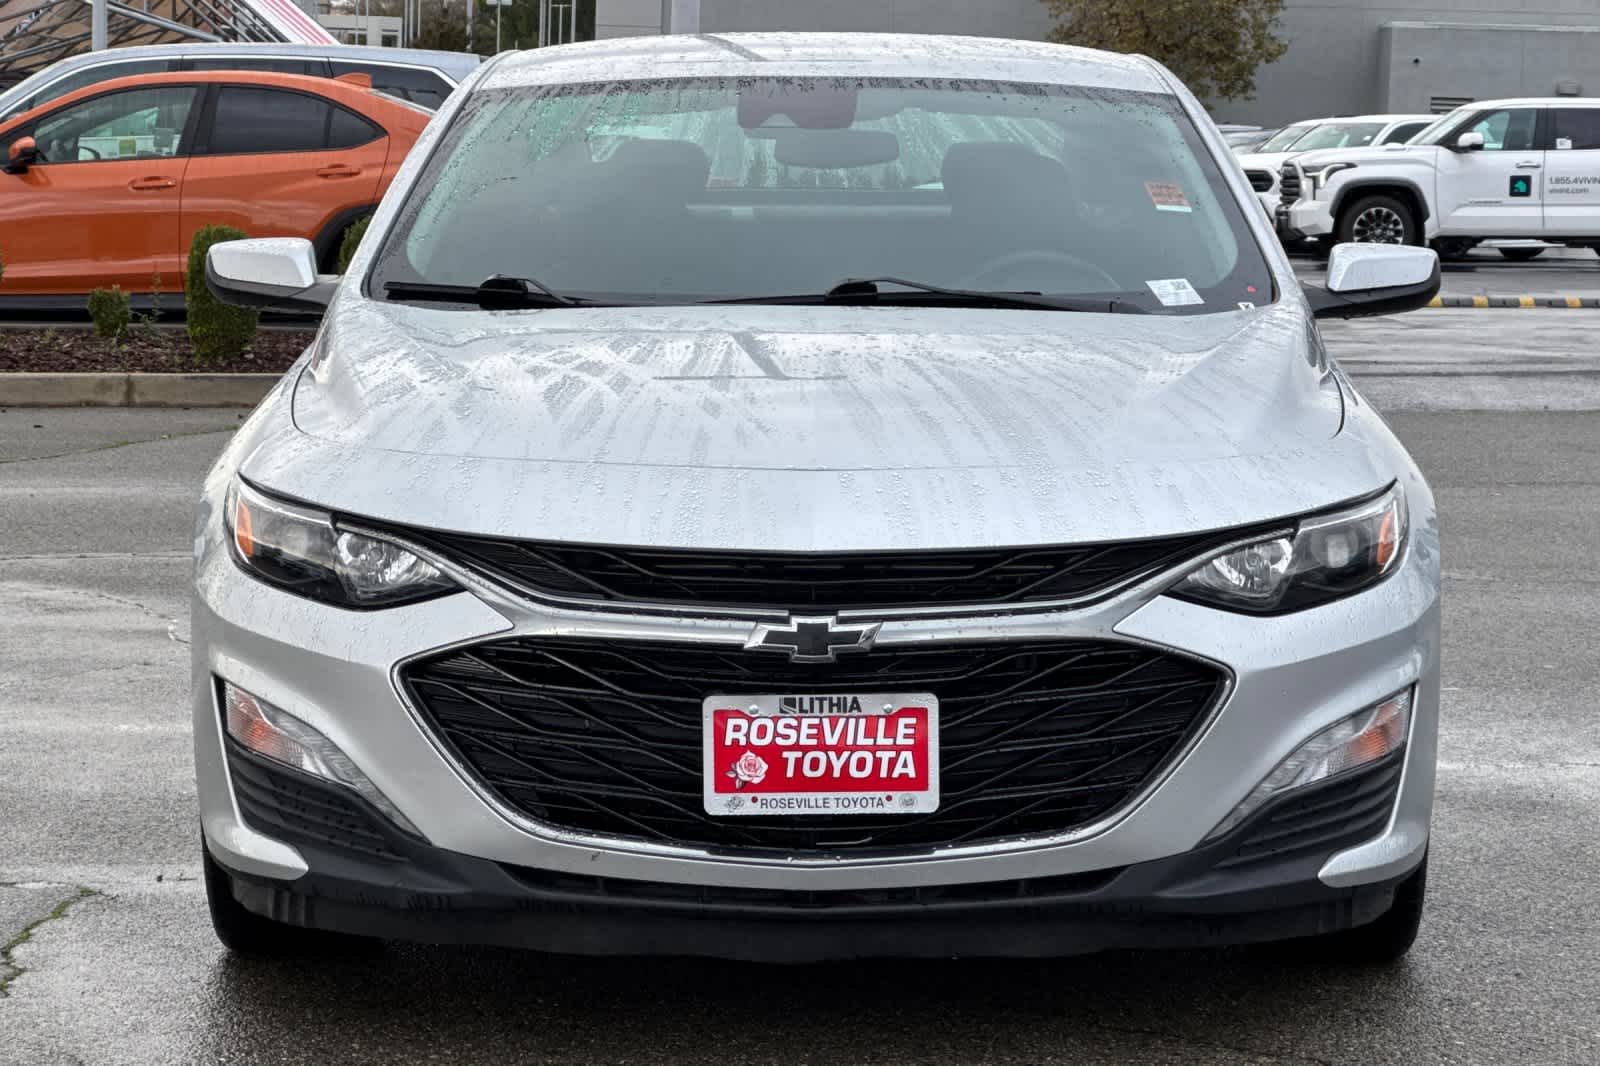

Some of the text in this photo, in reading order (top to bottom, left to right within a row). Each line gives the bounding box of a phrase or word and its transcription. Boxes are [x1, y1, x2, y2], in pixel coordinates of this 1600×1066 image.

[798, 696, 862, 714] LITHIA
[724, 717, 917, 746] ROSEVILLE
[782, 750, 916, 779] TOYOTA
[760, 796, 884, 809] ROSEVILLE TOYOTA
